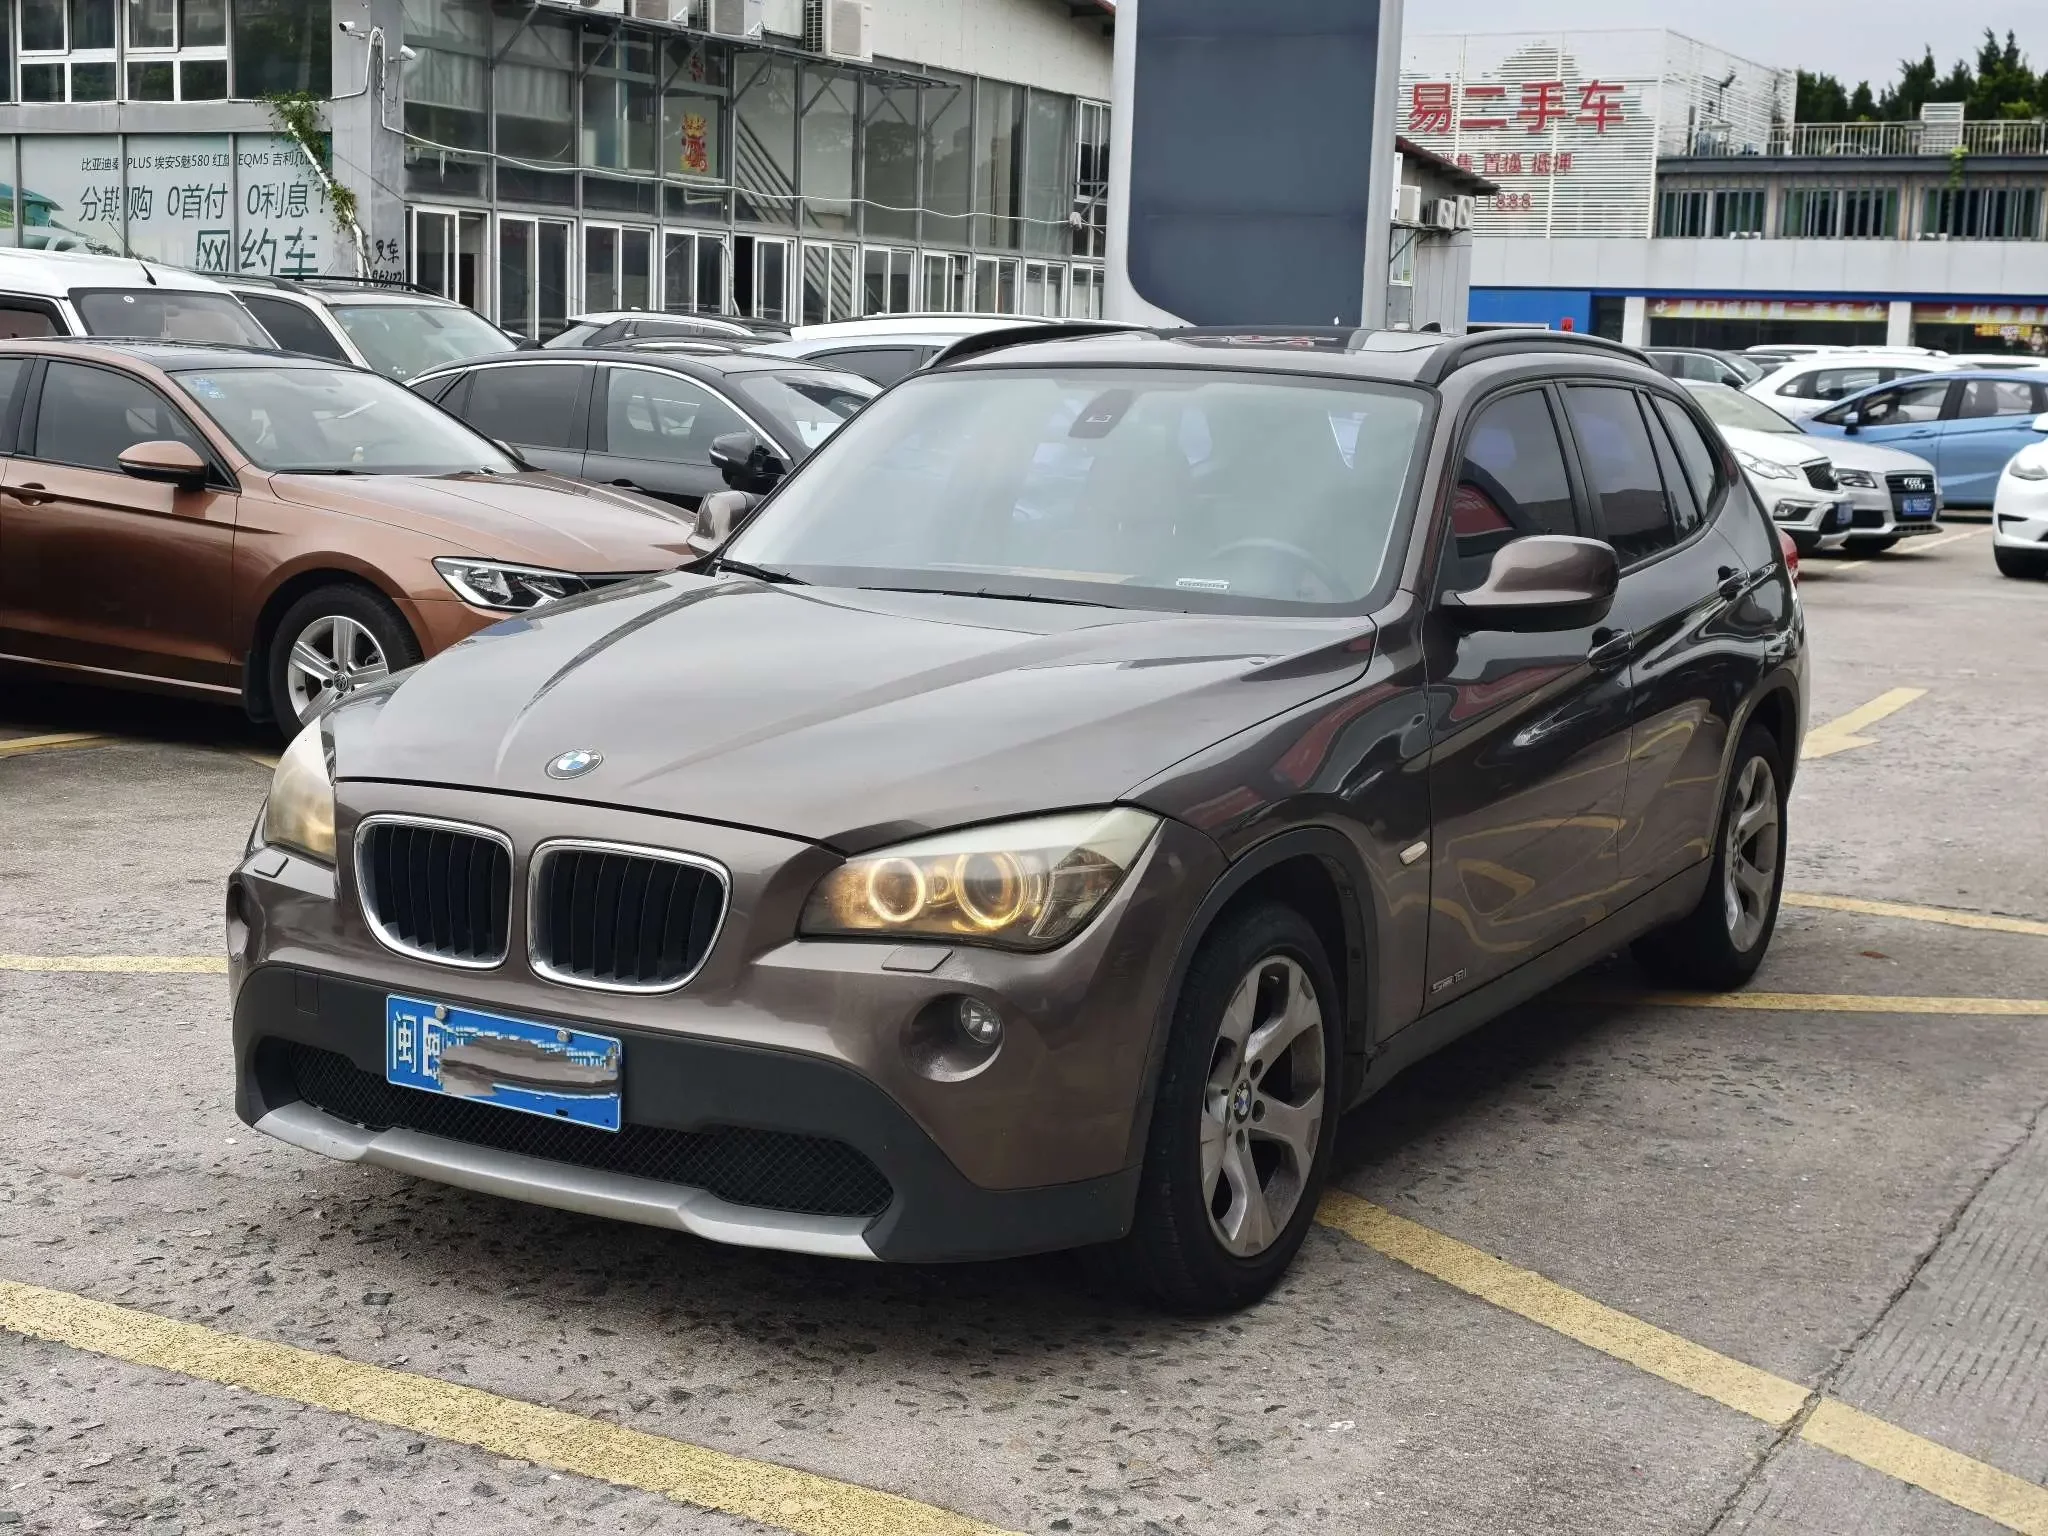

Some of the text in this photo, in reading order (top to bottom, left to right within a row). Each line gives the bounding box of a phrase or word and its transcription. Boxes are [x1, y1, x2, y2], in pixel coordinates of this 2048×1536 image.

[1407, 79, 1625, 134] 易二手车
[167, 183, 228, 220] 0首付
[196, 225, 318, 277] 网约车
